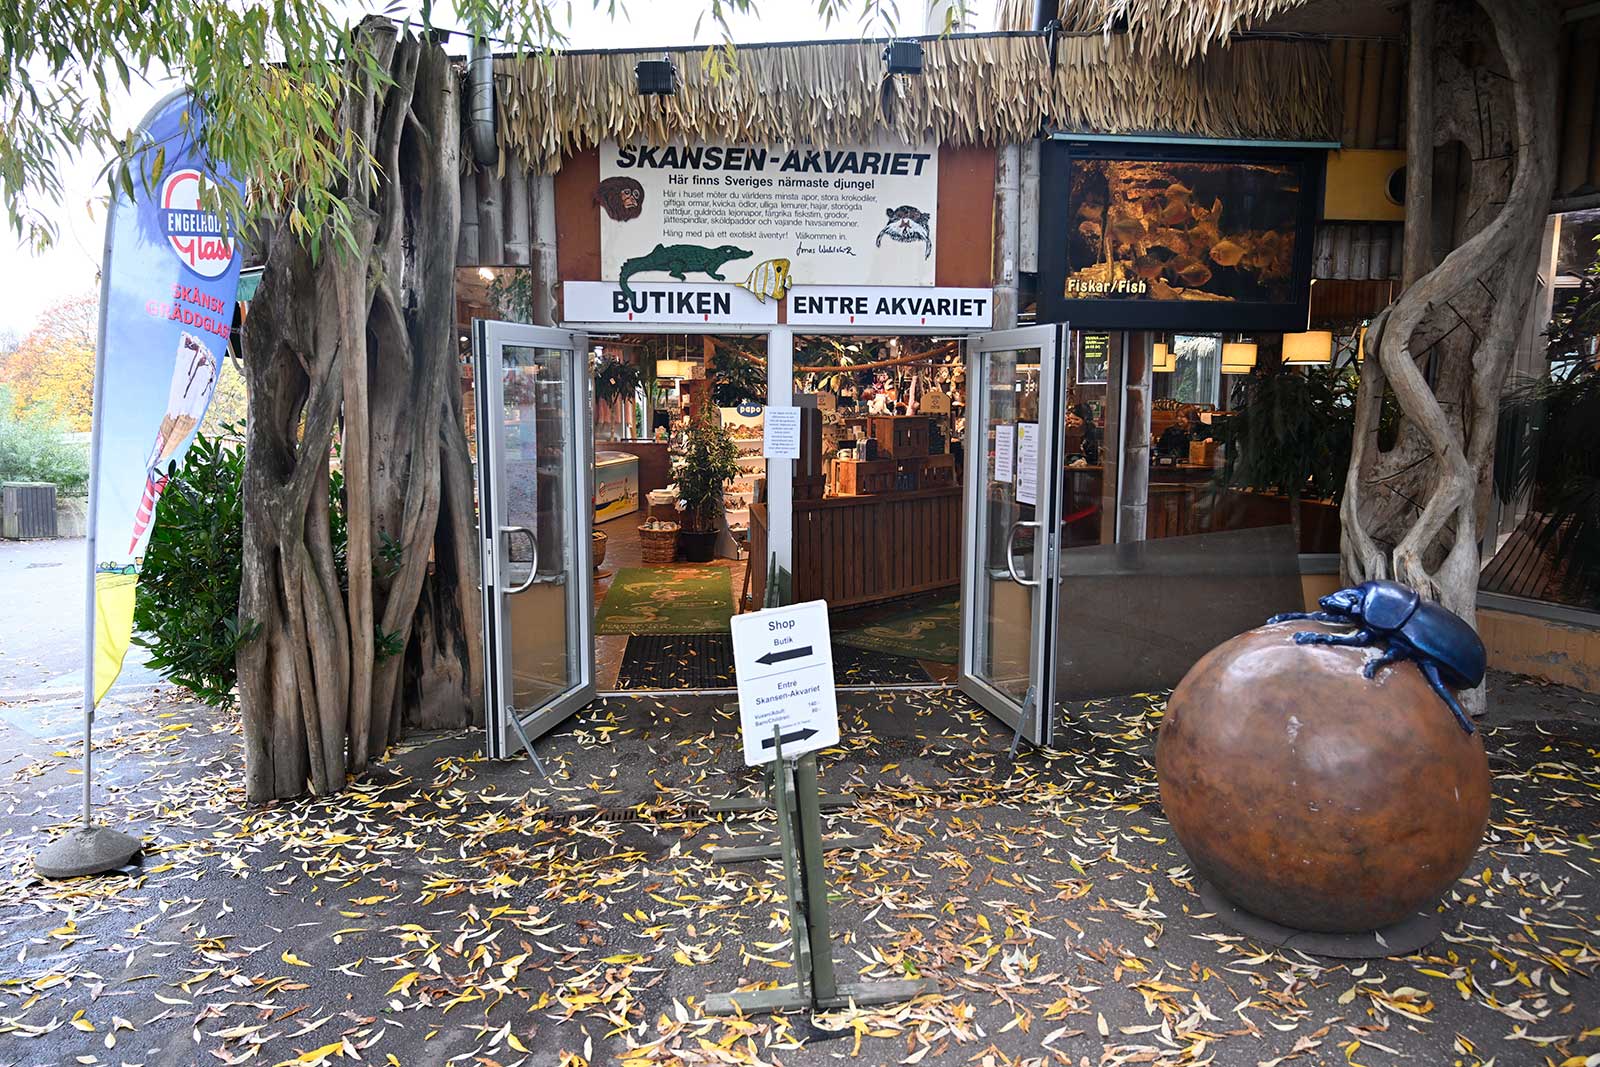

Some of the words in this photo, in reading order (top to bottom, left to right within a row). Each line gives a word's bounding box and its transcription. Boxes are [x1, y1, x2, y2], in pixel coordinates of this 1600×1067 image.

[616, 145, 930, 176] SKANSEN-AKVARIET
[668, 174, 688, 186] Här
[692, 174, 720, 186] finns
[725, 176, 773, 189] Sveriges
[778, 176, 829, 188] närmaste
[834, 178, 875, 191] djungel
[742, 191, 772, 200] världens
[841, 194, 877, 202] krokodiler,
[738, 200, 758, 209] ödlor,
[760, 201, 778, 209] ulliga
[810, 202, 829, 211] hajar,
[831, 202, 862, 211] storögda
[694, 208, 726, 217] guldröda
[729, 209, 763, 218] lejonapor,
[765, 209, 792, 218] färgrika
[824, 211, 849, 219] grodor,
[663, 216, 709, 224] jättespindlar,
[711, 216, 756, 225] sköldpaddor
[805, 219, 859, 227] havsanemoner.
[663, 229, 683, 238] Häng
[795, 232, 836, 240] Välkommen
[1067, 279, 1146, 294] Fiskar/Fish
[171, 283, 224, 316] SKÅNSK
[613, 291, 731, 314] BUTIKEN
[794, 296, 868, 315] ENTRE
[875, 297, 987, 317] AKVARIET
[740, 406, 761, 414] papo
[768, 619, 796, 631] Shop
[774, 637, 793, 646] Butik
[755, 685, 820, 706] Skansen-Akvariet
